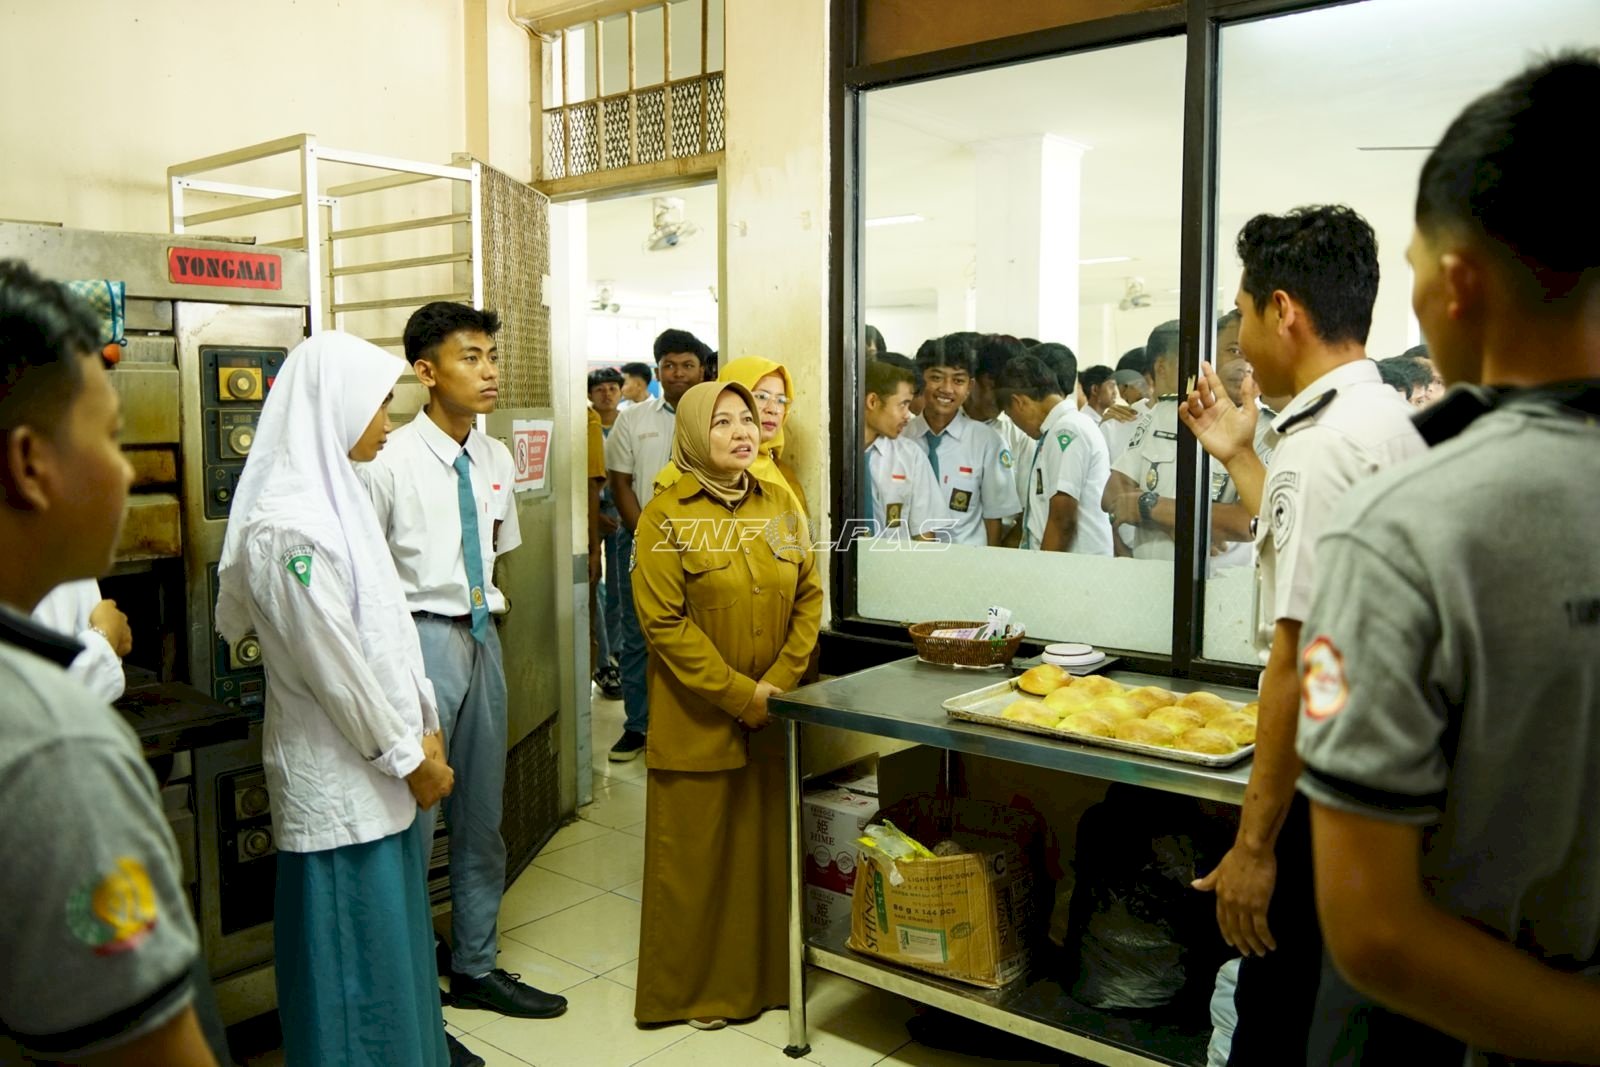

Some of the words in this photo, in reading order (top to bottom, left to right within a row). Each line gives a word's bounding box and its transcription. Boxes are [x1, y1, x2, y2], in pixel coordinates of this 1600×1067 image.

[176, 255, 275, 282] YONGMAI
[809, 832, 836, 846] HIME
[907, 874, 953, 884] LIGHTENING
[955, 871, 976, 880] SOAP
